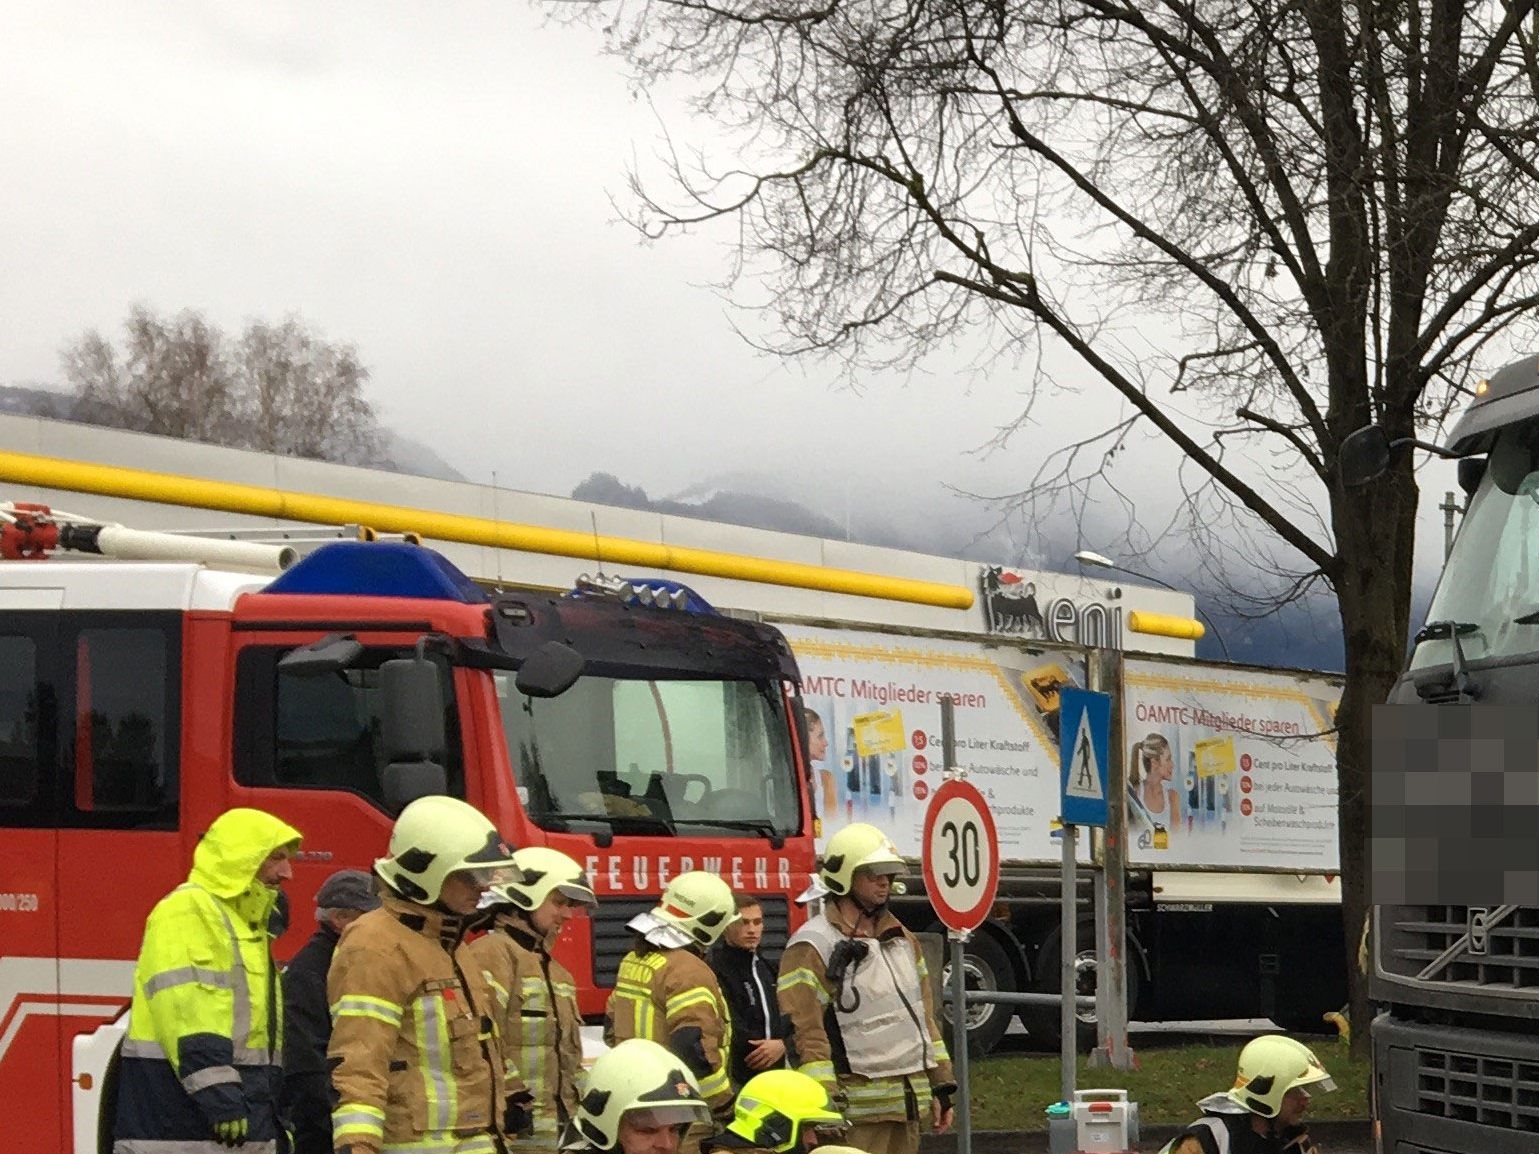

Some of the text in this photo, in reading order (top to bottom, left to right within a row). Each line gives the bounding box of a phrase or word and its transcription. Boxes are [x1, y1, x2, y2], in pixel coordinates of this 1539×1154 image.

[1049, 587, 1122, 648] eni
[851, 679, 931, 706] Mitglieder
[1136, 701, 1299, 735] ÖAMTC Mitglieder sparen
[990, 739, 1031, 752] Kraftstoff
[941, 820, 980, 889] 30
[586, 855, 792, 891] FEUERWEHR
